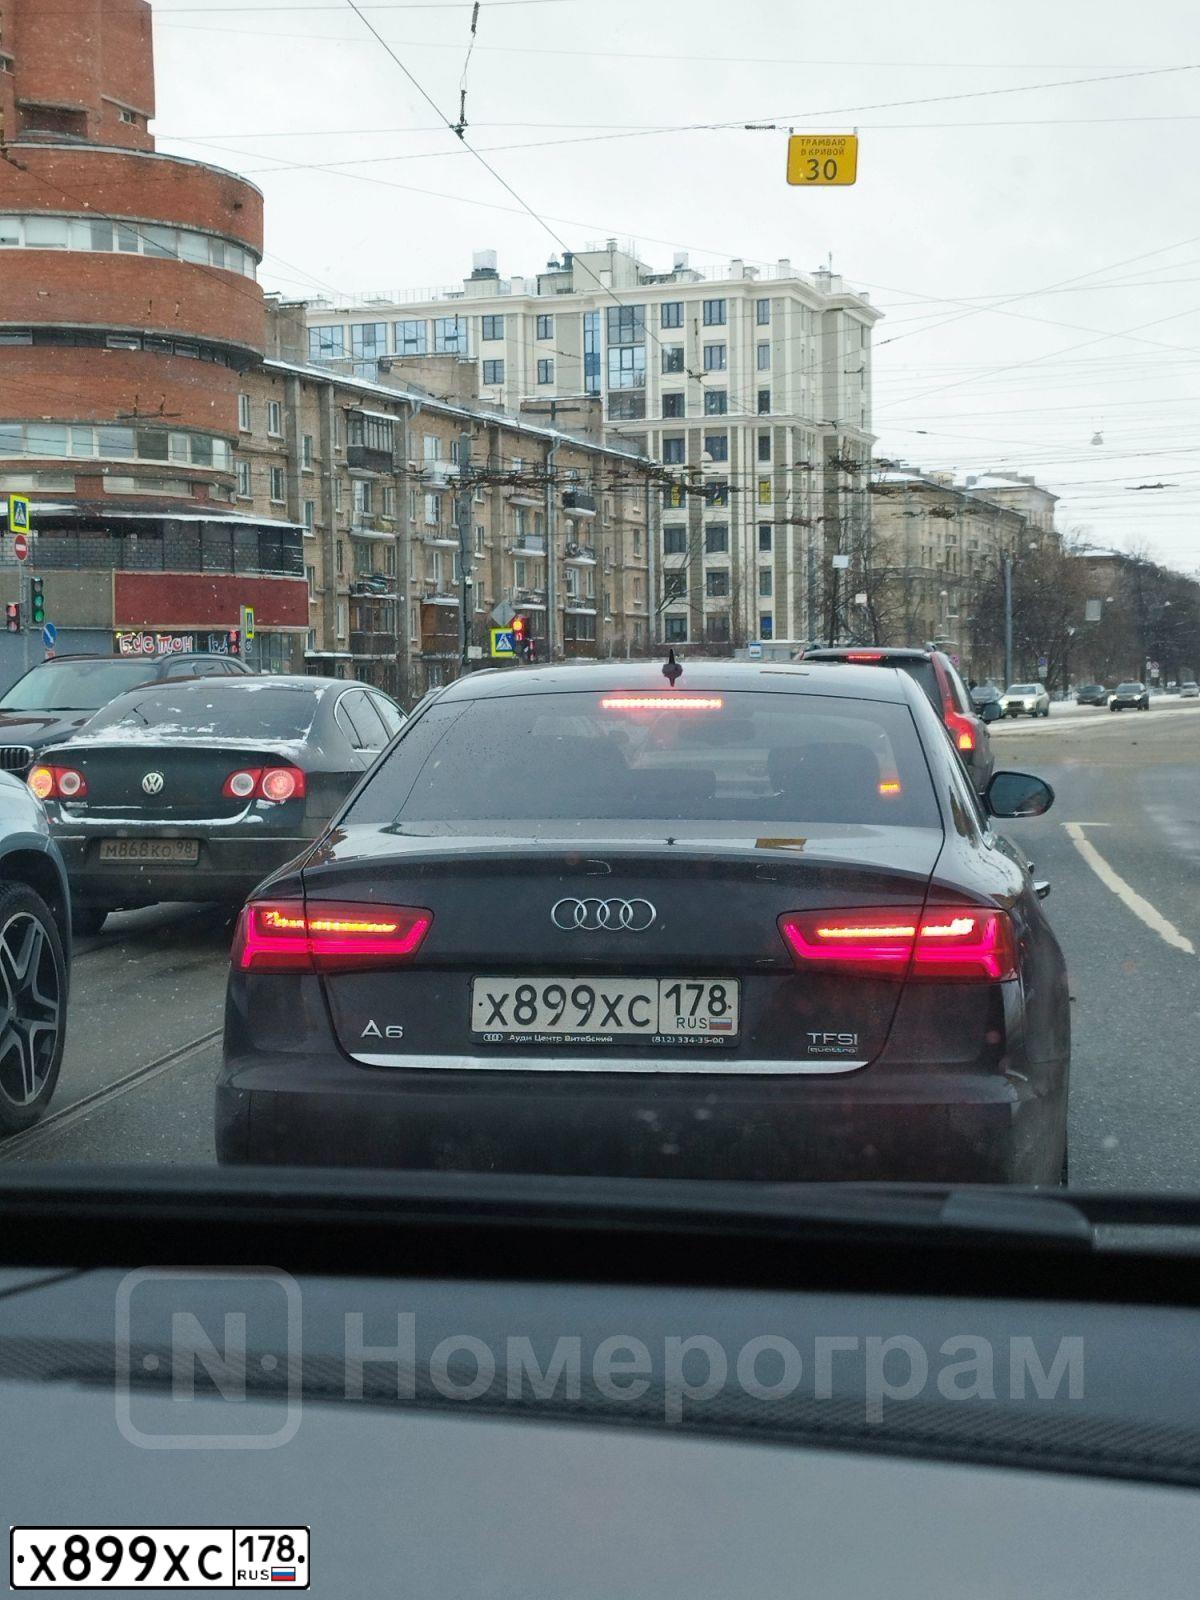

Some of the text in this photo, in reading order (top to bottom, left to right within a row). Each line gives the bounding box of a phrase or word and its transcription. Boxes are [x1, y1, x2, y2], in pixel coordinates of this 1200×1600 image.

[800, 138, 846, 146] ТРАМВАЮ
[808, 147, 845, 156] КРИВОЙ
[806, 158, 838, 181] 30
[664, 983, 728, 1017] 178
[360, 1019, 404, 1039] A6
[676, 1016, 708, 1030] RUS
[509, 1034, 533, 1042] Ауди
[534, 1034, 562, 1042] Центр
[564, 1035, 613, 1043] Витебский
[651, 1036, 676, 1044] (812)
[806, 1032, 858, 1046] TFSI
